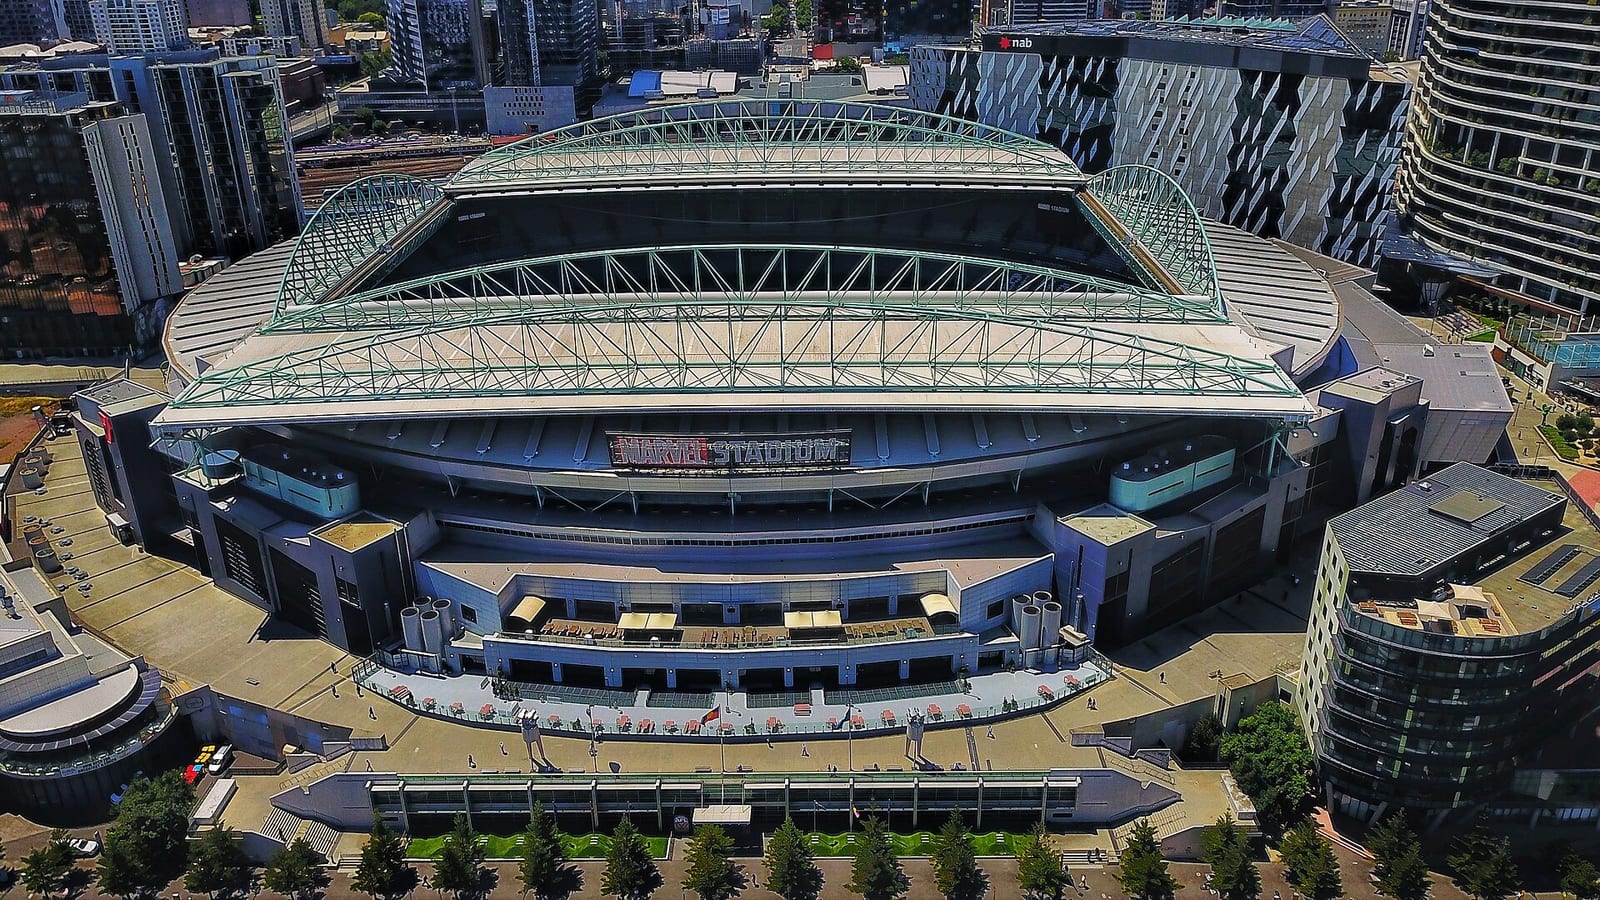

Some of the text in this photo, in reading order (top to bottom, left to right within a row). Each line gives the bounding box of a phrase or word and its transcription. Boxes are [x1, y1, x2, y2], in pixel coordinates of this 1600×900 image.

[1012, 38, 1032, 48] nab
[619, 438, 837, 464] MARVEL STADIUM
